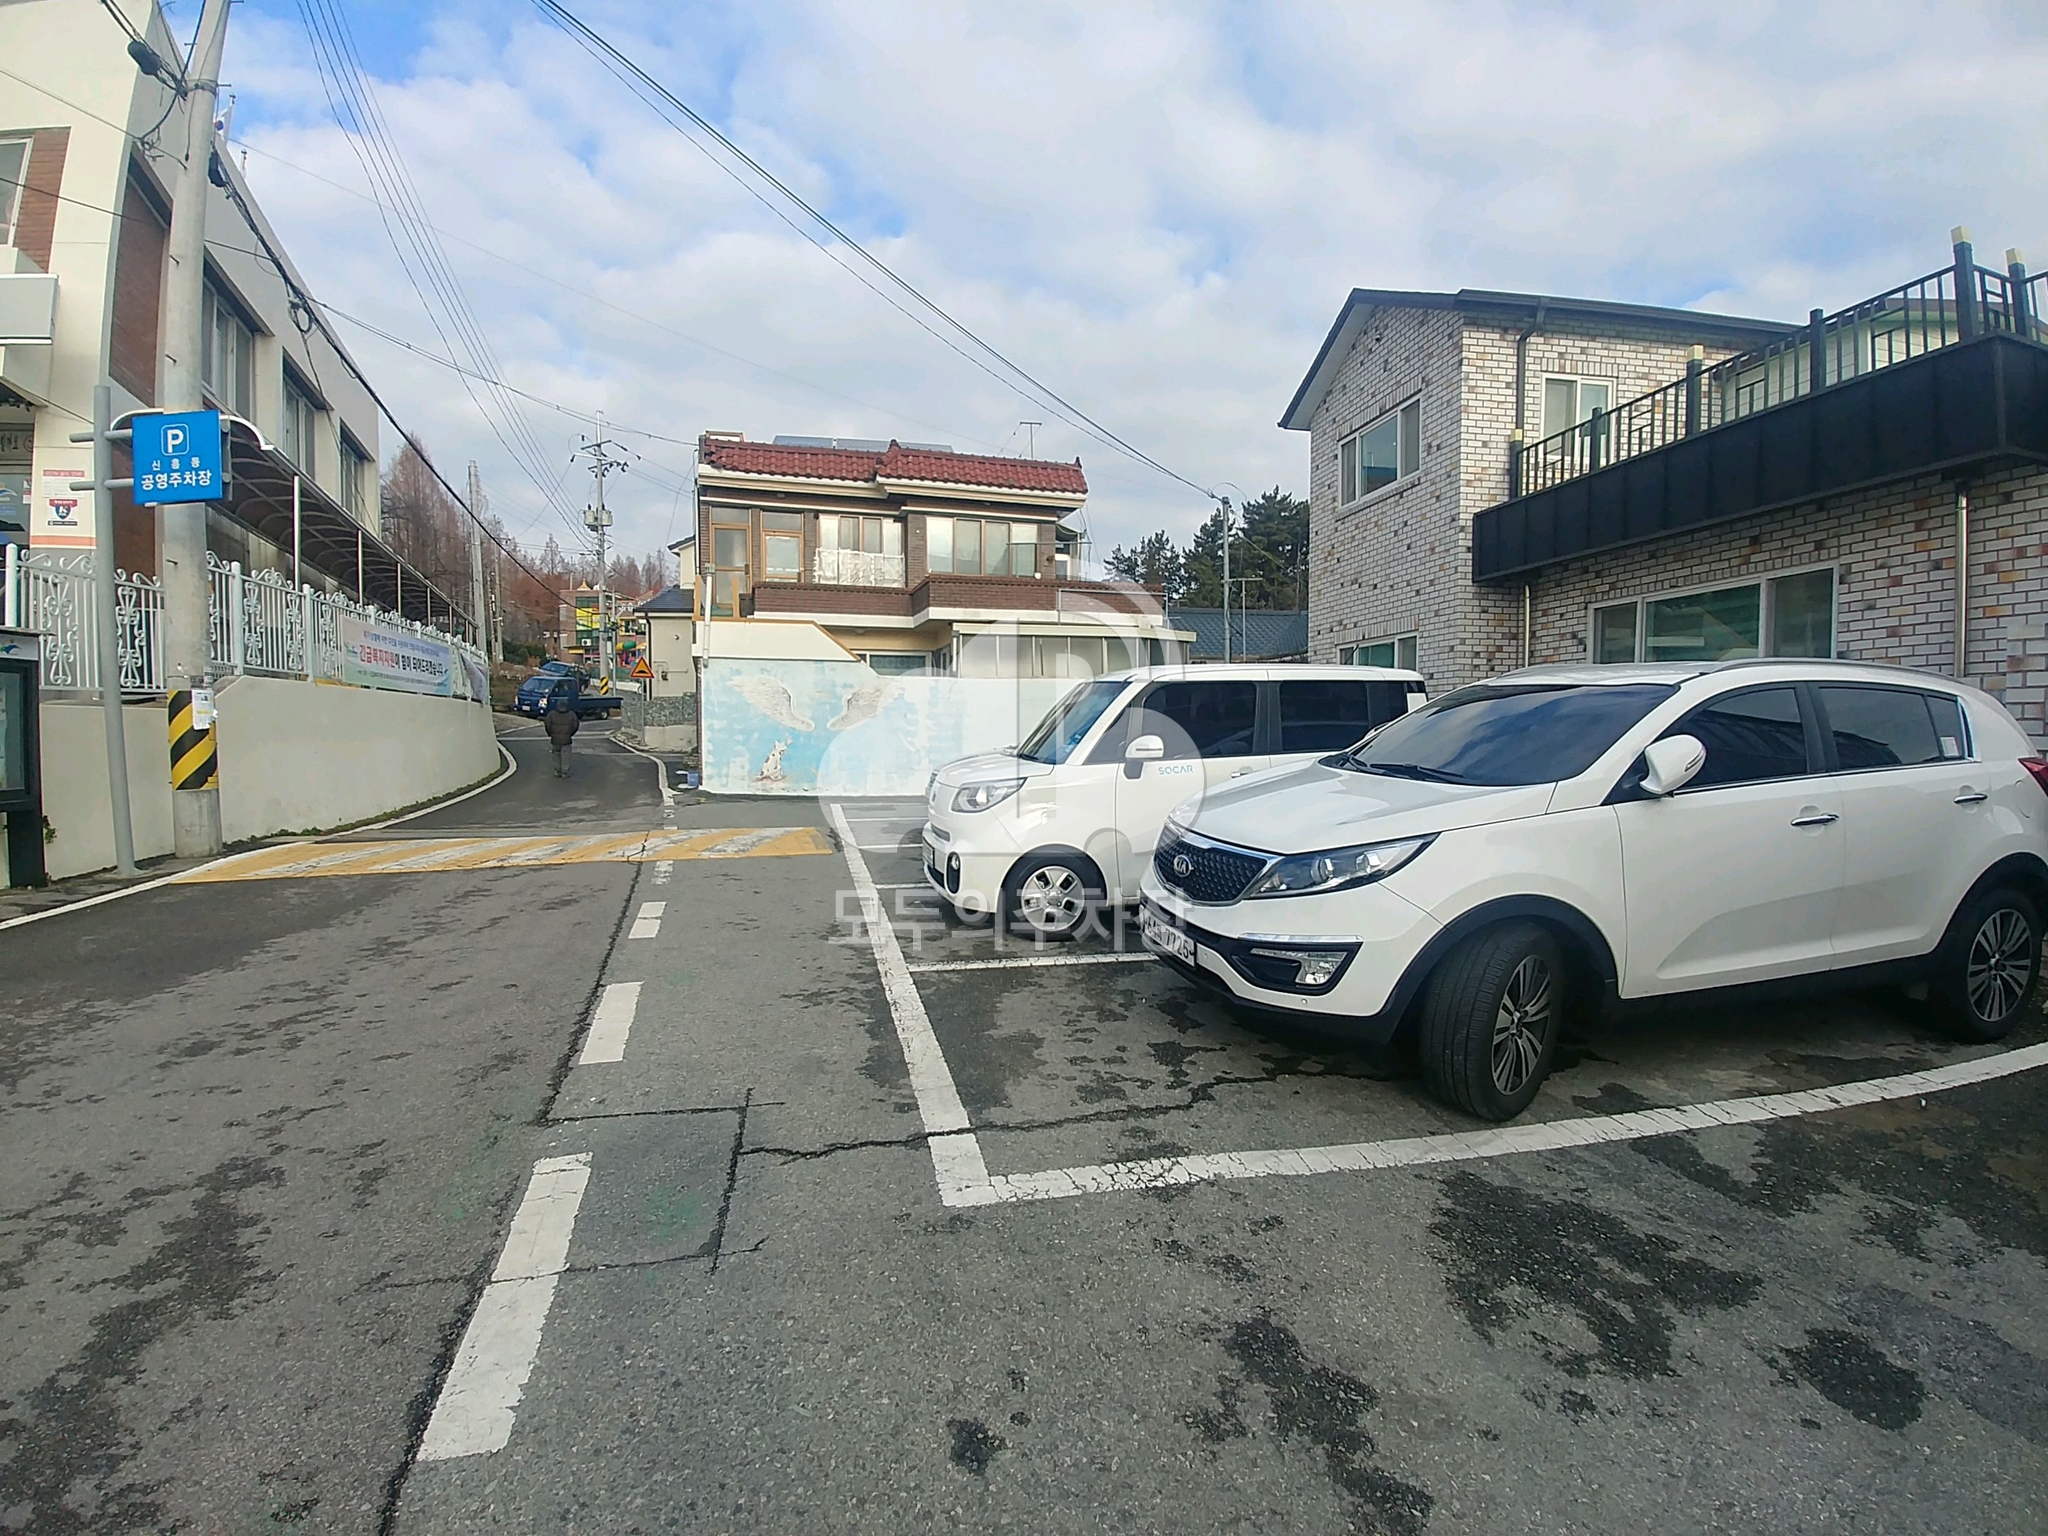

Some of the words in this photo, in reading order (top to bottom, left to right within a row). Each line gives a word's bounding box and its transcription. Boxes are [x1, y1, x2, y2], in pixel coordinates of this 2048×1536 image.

[166, 428, 184, 453] P
[141, 469, 212, 491] 공영주차장
[1158, 764, 1194, 775] SOCAR
